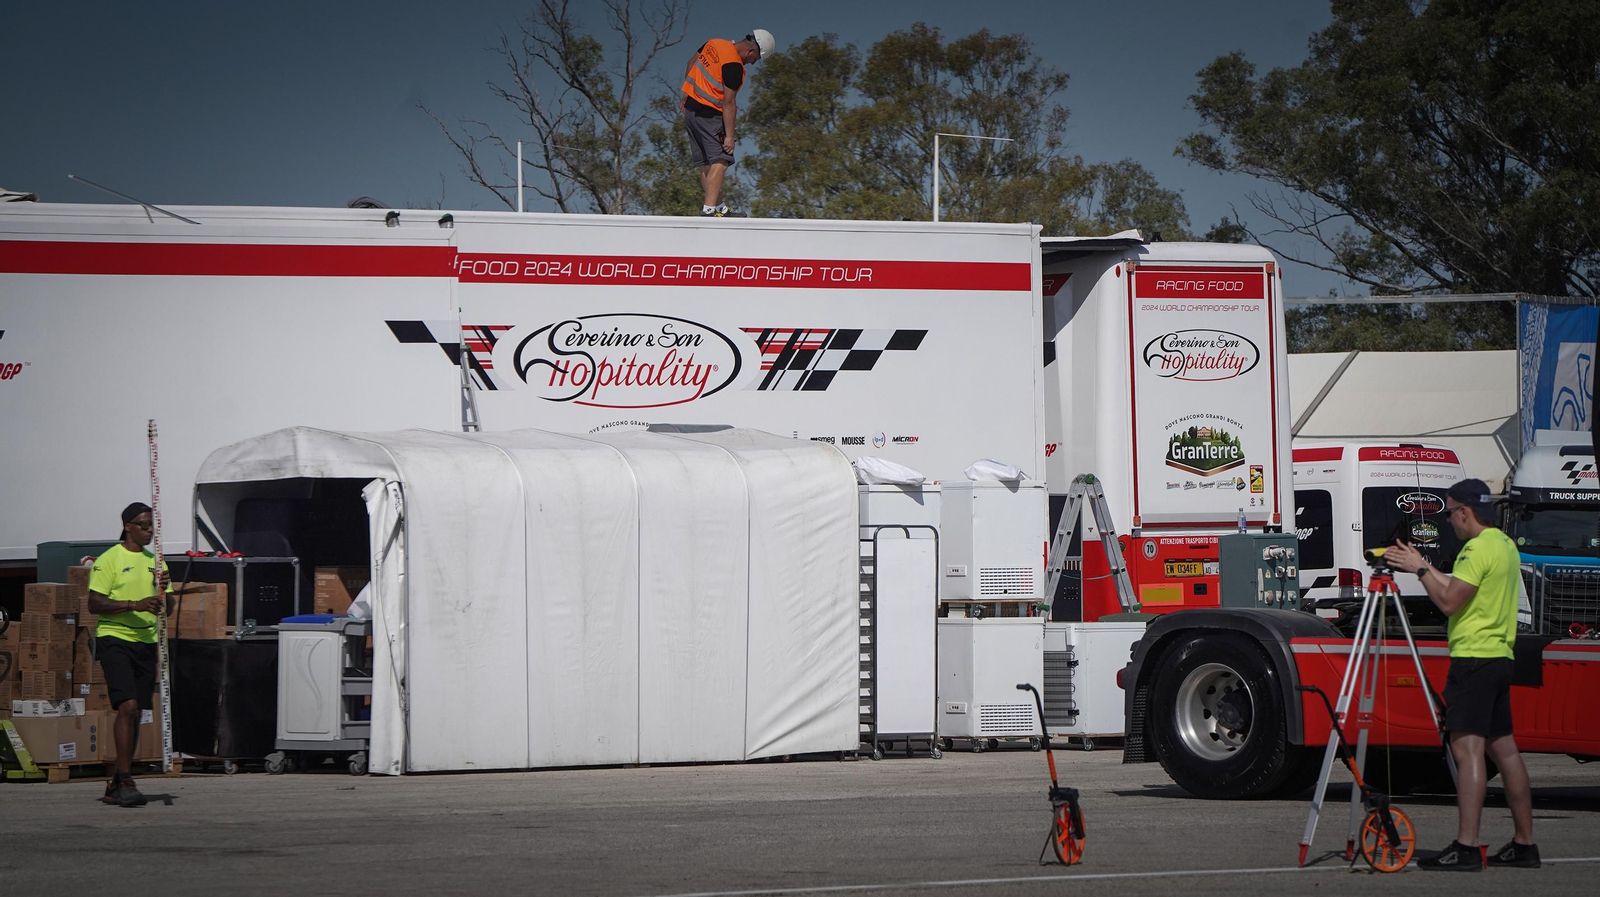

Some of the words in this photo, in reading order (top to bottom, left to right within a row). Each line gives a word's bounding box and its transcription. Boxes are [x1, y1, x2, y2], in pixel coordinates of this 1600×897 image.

[459, 260, 519, 276] FOOD
[524, 261, 572, 277] 2024
[578, 262, 657, 279] WORLD
[661, 264, 814, 282] CHAMPIONSHIP
[819, 266, 873, 282] TOUR
[1155, 280, 1205, 291] RACING
[1207, 281, 1244, 291] FOOD
[1159, 304, 1186, 312] WORLD
[1187, 304, 1240, 312] CHAMPIONSHIP
[1240, 304, 1260, 312] TOUR
[657, 323, 704, 349] Son
[1216, 334, 1241, 349] Son
[588, 426, 600, 434] OVE
[601, 420, 629, 430] NASCONO
[629, 420, 650, 428] GRAND
[1164, 419, 1179, 431] DOVE
[1179, 413, 1205, 423] NASCONO
[1205, 413, 1226, 421] GRANDI
[841, 437, 865, 445] MOUSSE
[1171, 441, 1239, 460] GranTerre
[1379, 449, 1419, 459] RACING
[1420, 451, 1446, 460] FOOD
[1550, 492, 1575, 500] TRUCK
[1411, 528, 1438, 537] GranTerre
[1185, 537, 1209, 545] TRASPORTO
[1146, 544, 1155, 554] 70
[1166, 564, 1175, 574] EW
[1177, 563, 1198, 574] 034FF
